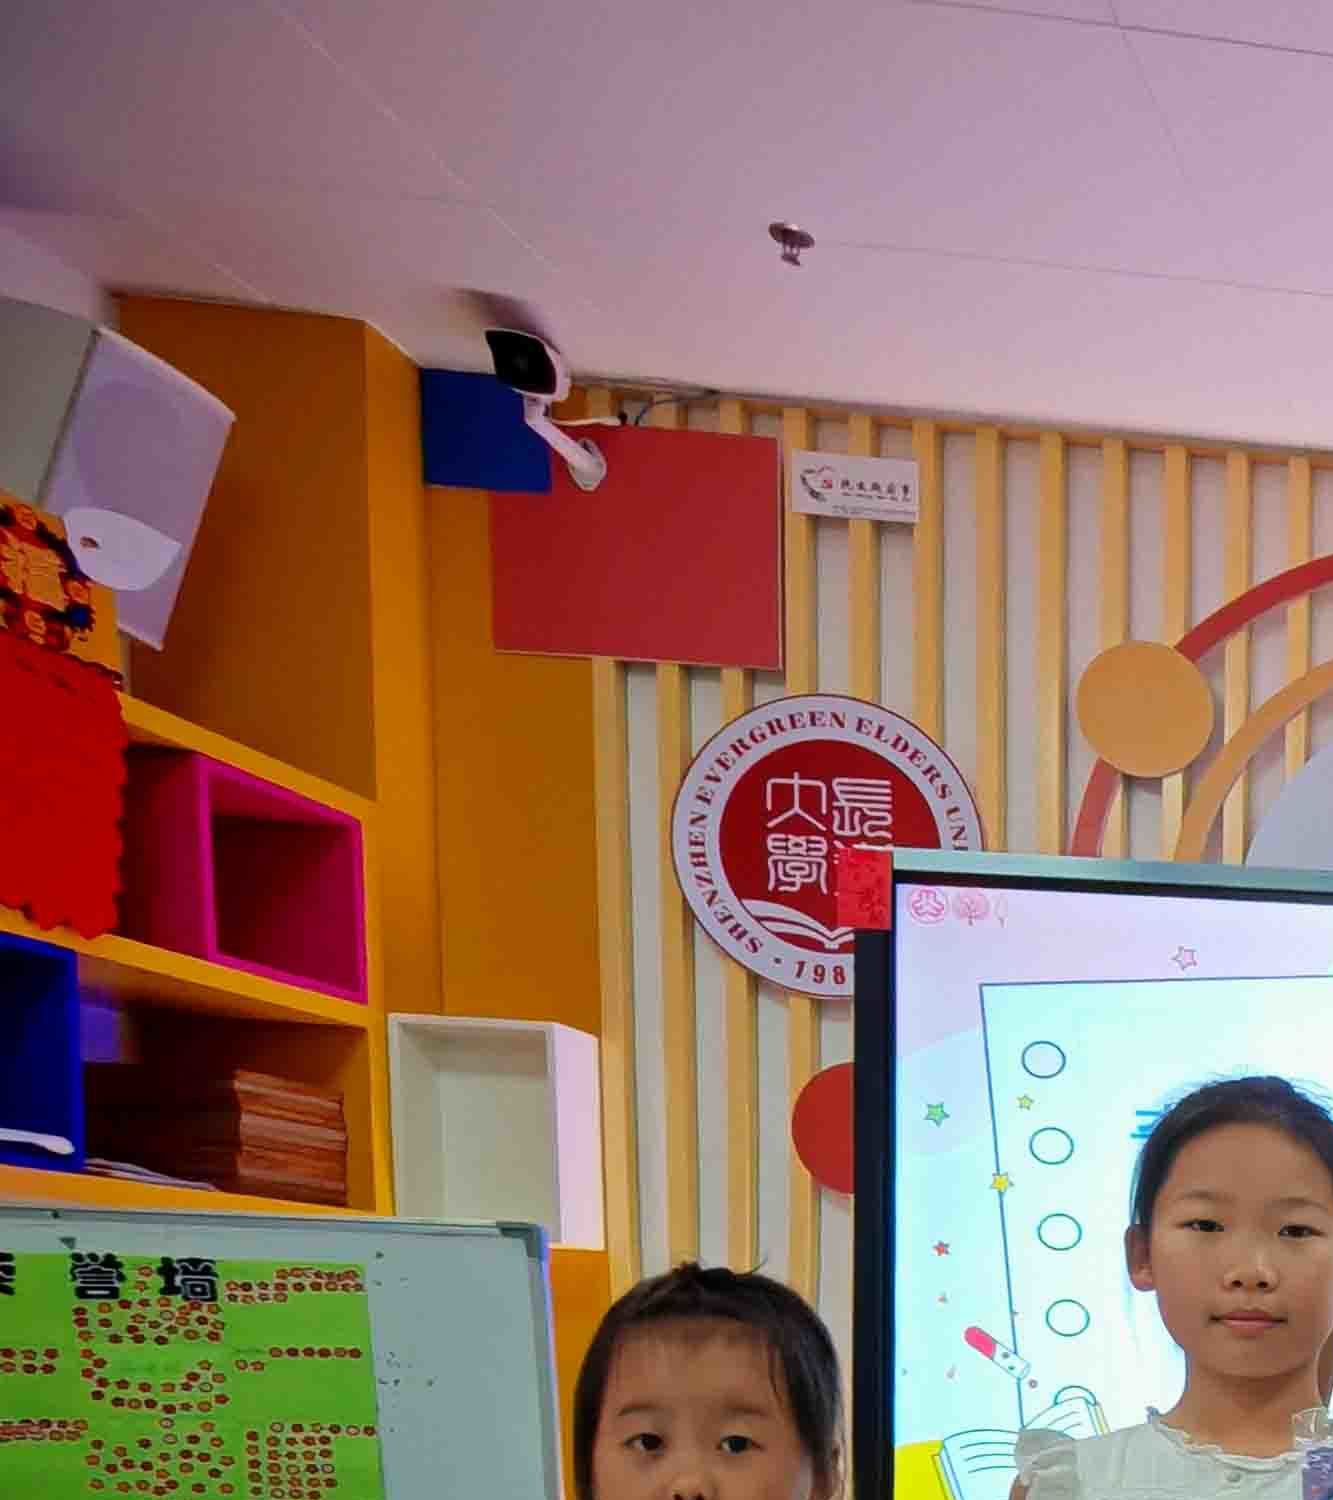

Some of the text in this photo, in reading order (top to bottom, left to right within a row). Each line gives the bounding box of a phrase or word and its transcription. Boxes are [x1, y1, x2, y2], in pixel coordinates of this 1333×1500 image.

[694, 710, 847, 807] EVERGREEN
[855, 716, 953, 802] ELDERS
[687, 809, 765, 954] SHENZHEN
[0, 1252, 219, 1302] 誉墙
